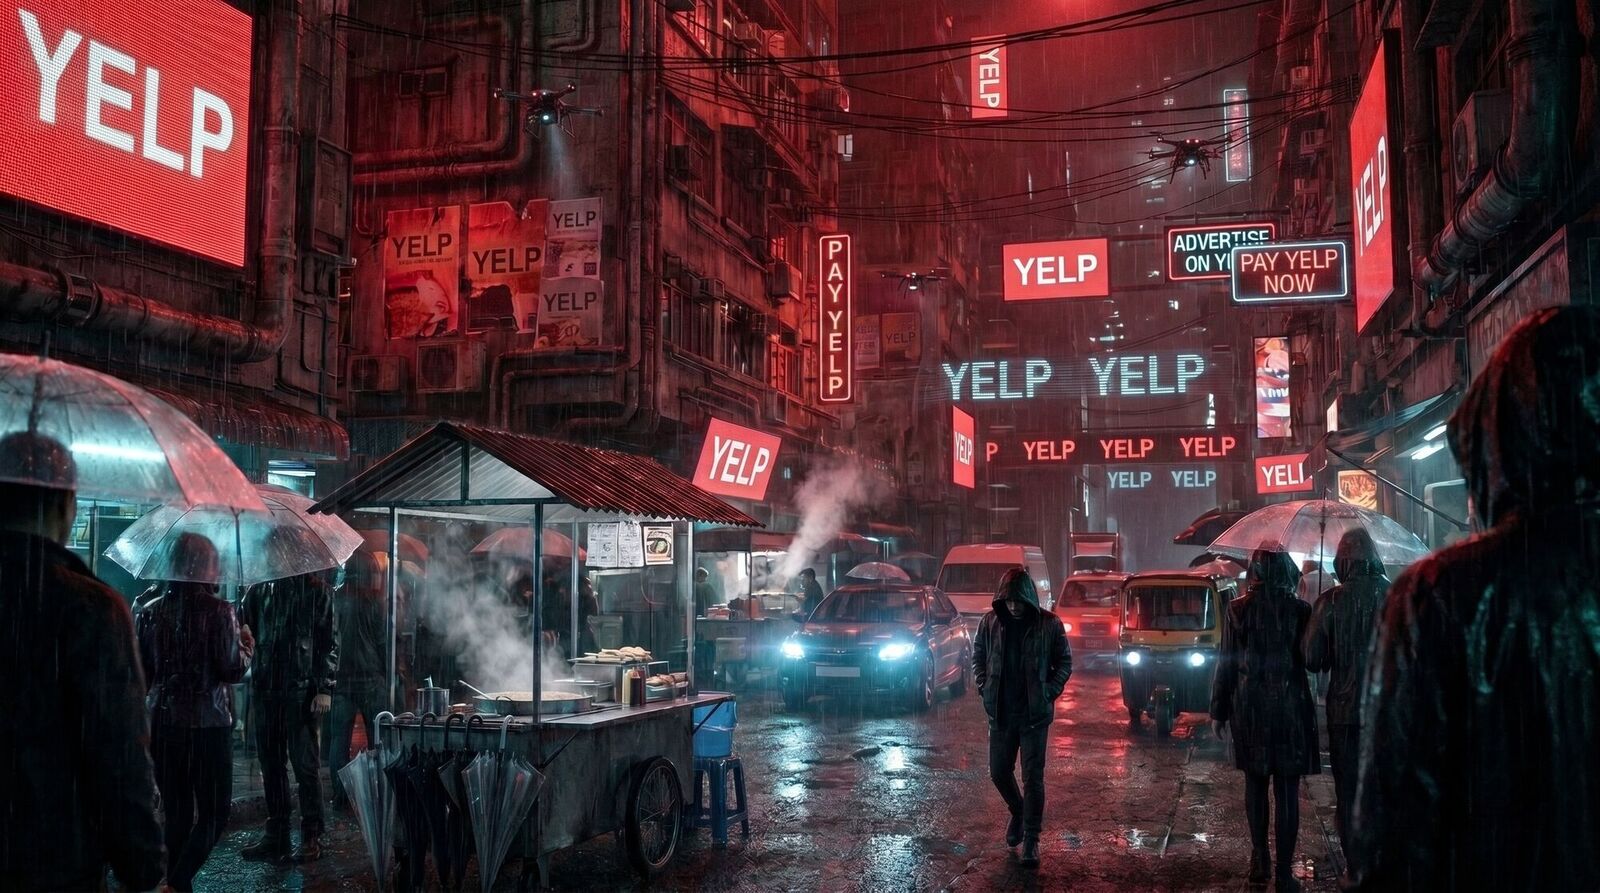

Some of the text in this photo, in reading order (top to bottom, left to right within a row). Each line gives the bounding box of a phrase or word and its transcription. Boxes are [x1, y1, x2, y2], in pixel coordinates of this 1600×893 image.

[979, 48, 1000, 108] YELP
[18, 8, 235, 179] YELP
[1355, 135, 1387, 256] YELP
[553, 210, 597, 229] YELP
[392, 233, 453, 259] YELP
[473, 247, 542, 275] YELP
[1013, 253, 1098, 286] YELP
[1185, 254, 1210, 273] ON
[1240, 248, 1339, 273] PAY YELP
[1264, 272, 1316, 295] NOW
[544, 292, 598, 313] YELP
[827, 240, 844, 396] PAY YELP
[885, 332, 916, 345] YELP
[942, 353, 1206, 401] YELP YELP
[709, 434, 770, 488] YELP
[954, 431, 973, 466] YELP
[1023, 439, 1076, 461] YELP
[1099, 437, 1154, 460] YELP
[1179, 436, 1236, 458] YELP
[1107, 470, 1217, 489] YELP YELP
